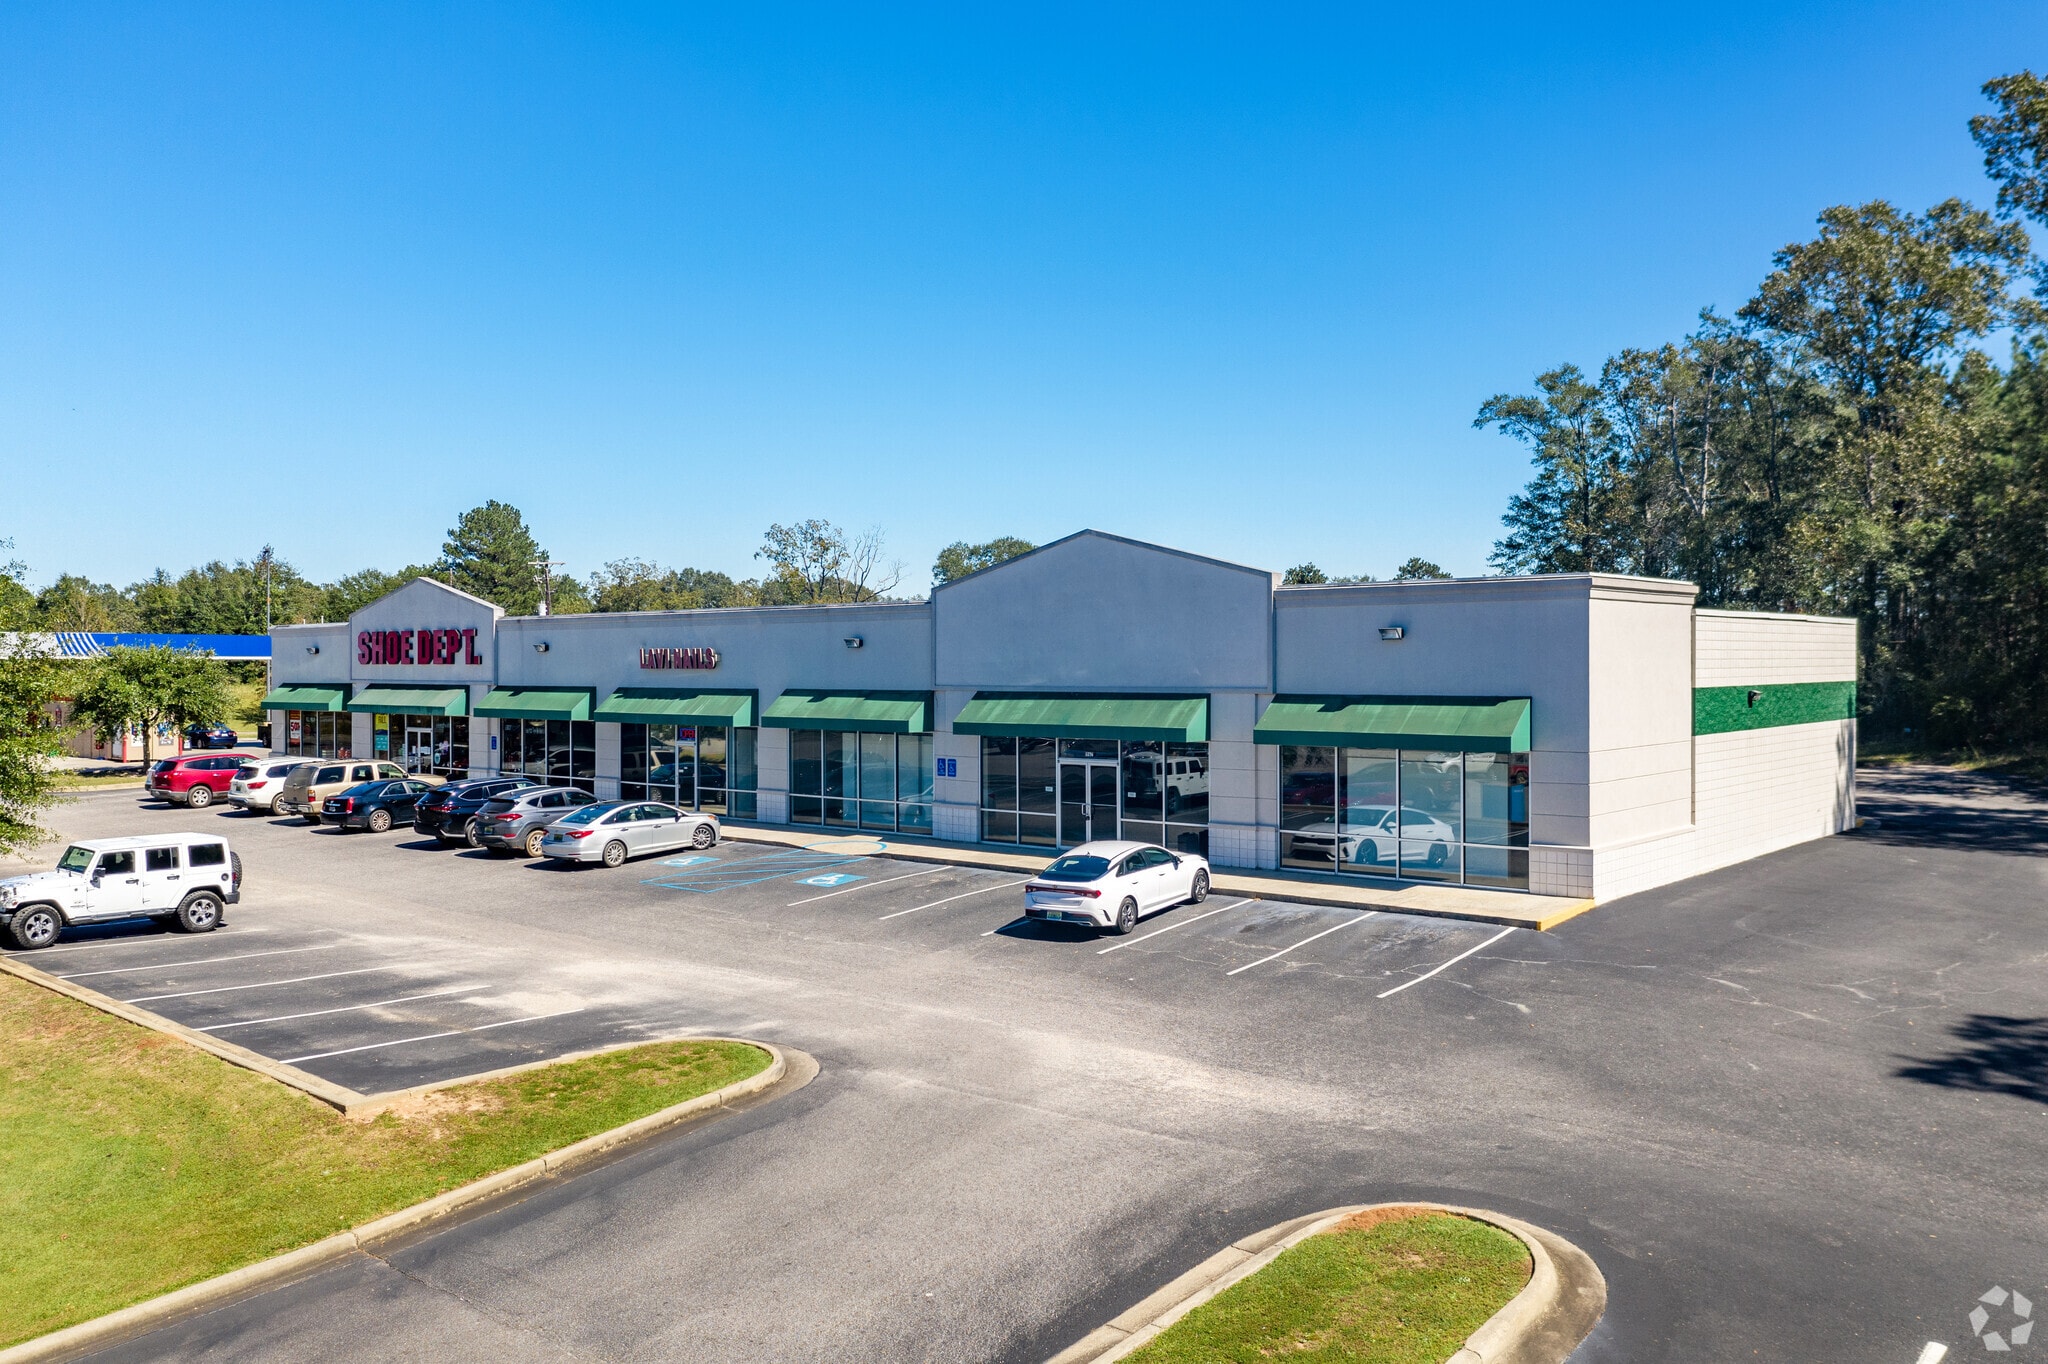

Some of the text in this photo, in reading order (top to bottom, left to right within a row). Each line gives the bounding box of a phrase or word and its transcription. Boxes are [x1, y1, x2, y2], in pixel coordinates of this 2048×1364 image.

[357, 628, 482, 665] SHOE DEPT.
[640, 648, 717, 669] LAVI NAILS
